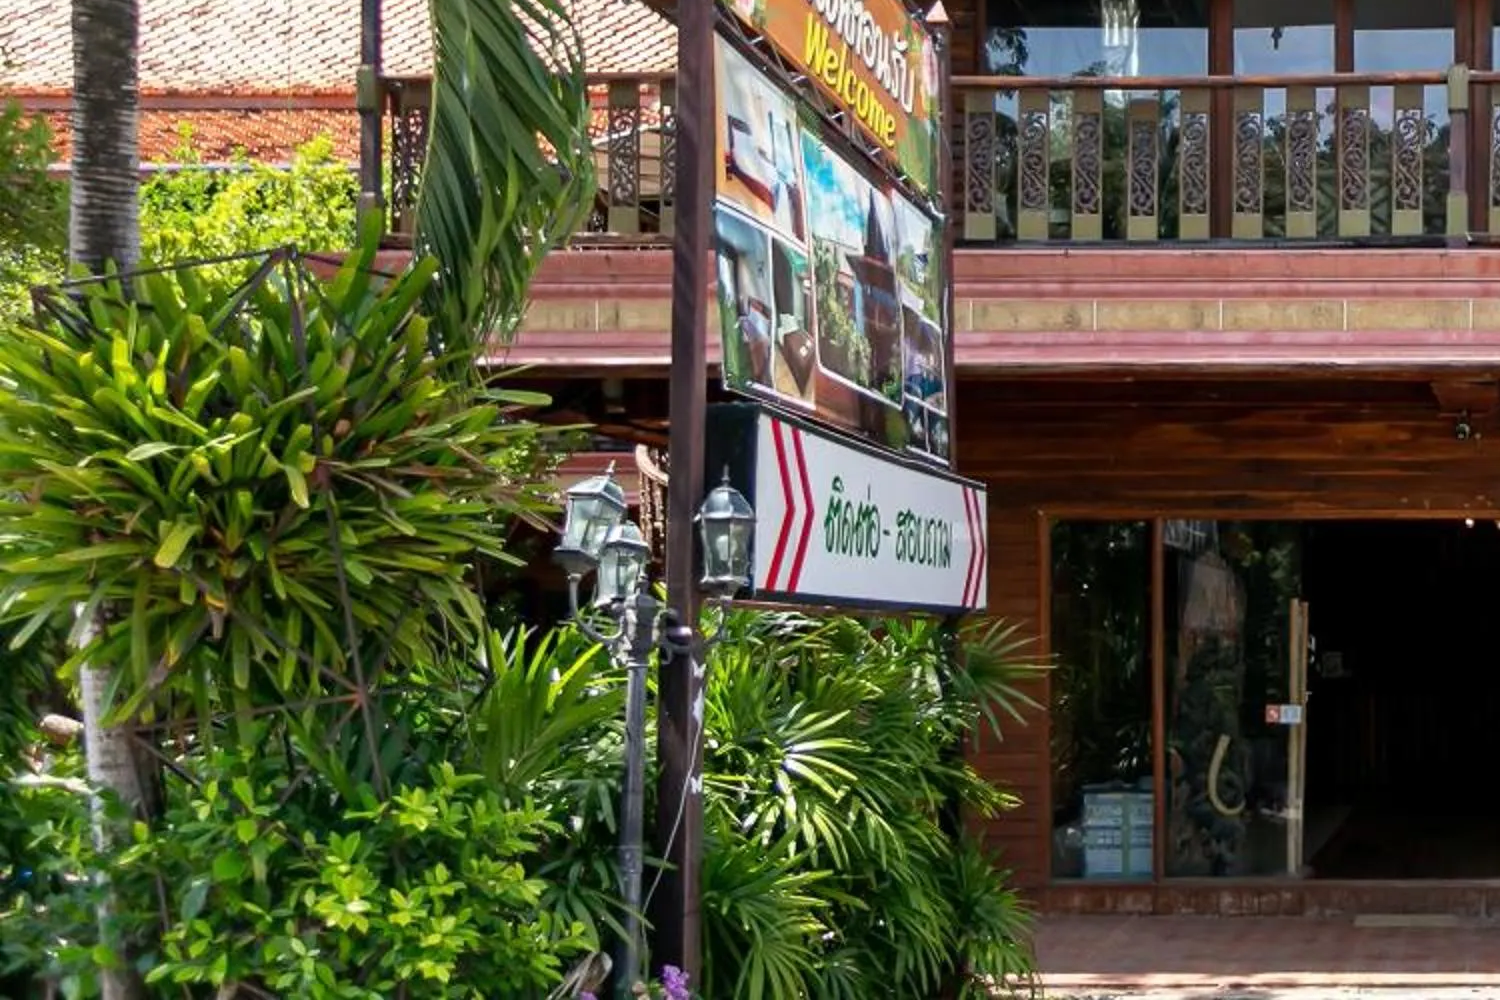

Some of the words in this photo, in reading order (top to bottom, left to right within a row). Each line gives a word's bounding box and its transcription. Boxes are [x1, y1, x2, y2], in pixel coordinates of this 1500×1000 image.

[804, 13, 896, 147] Welcome
[824, 475, 880, 558] ติดต่อ
[896, 509, 952, 568] สอบถาม
